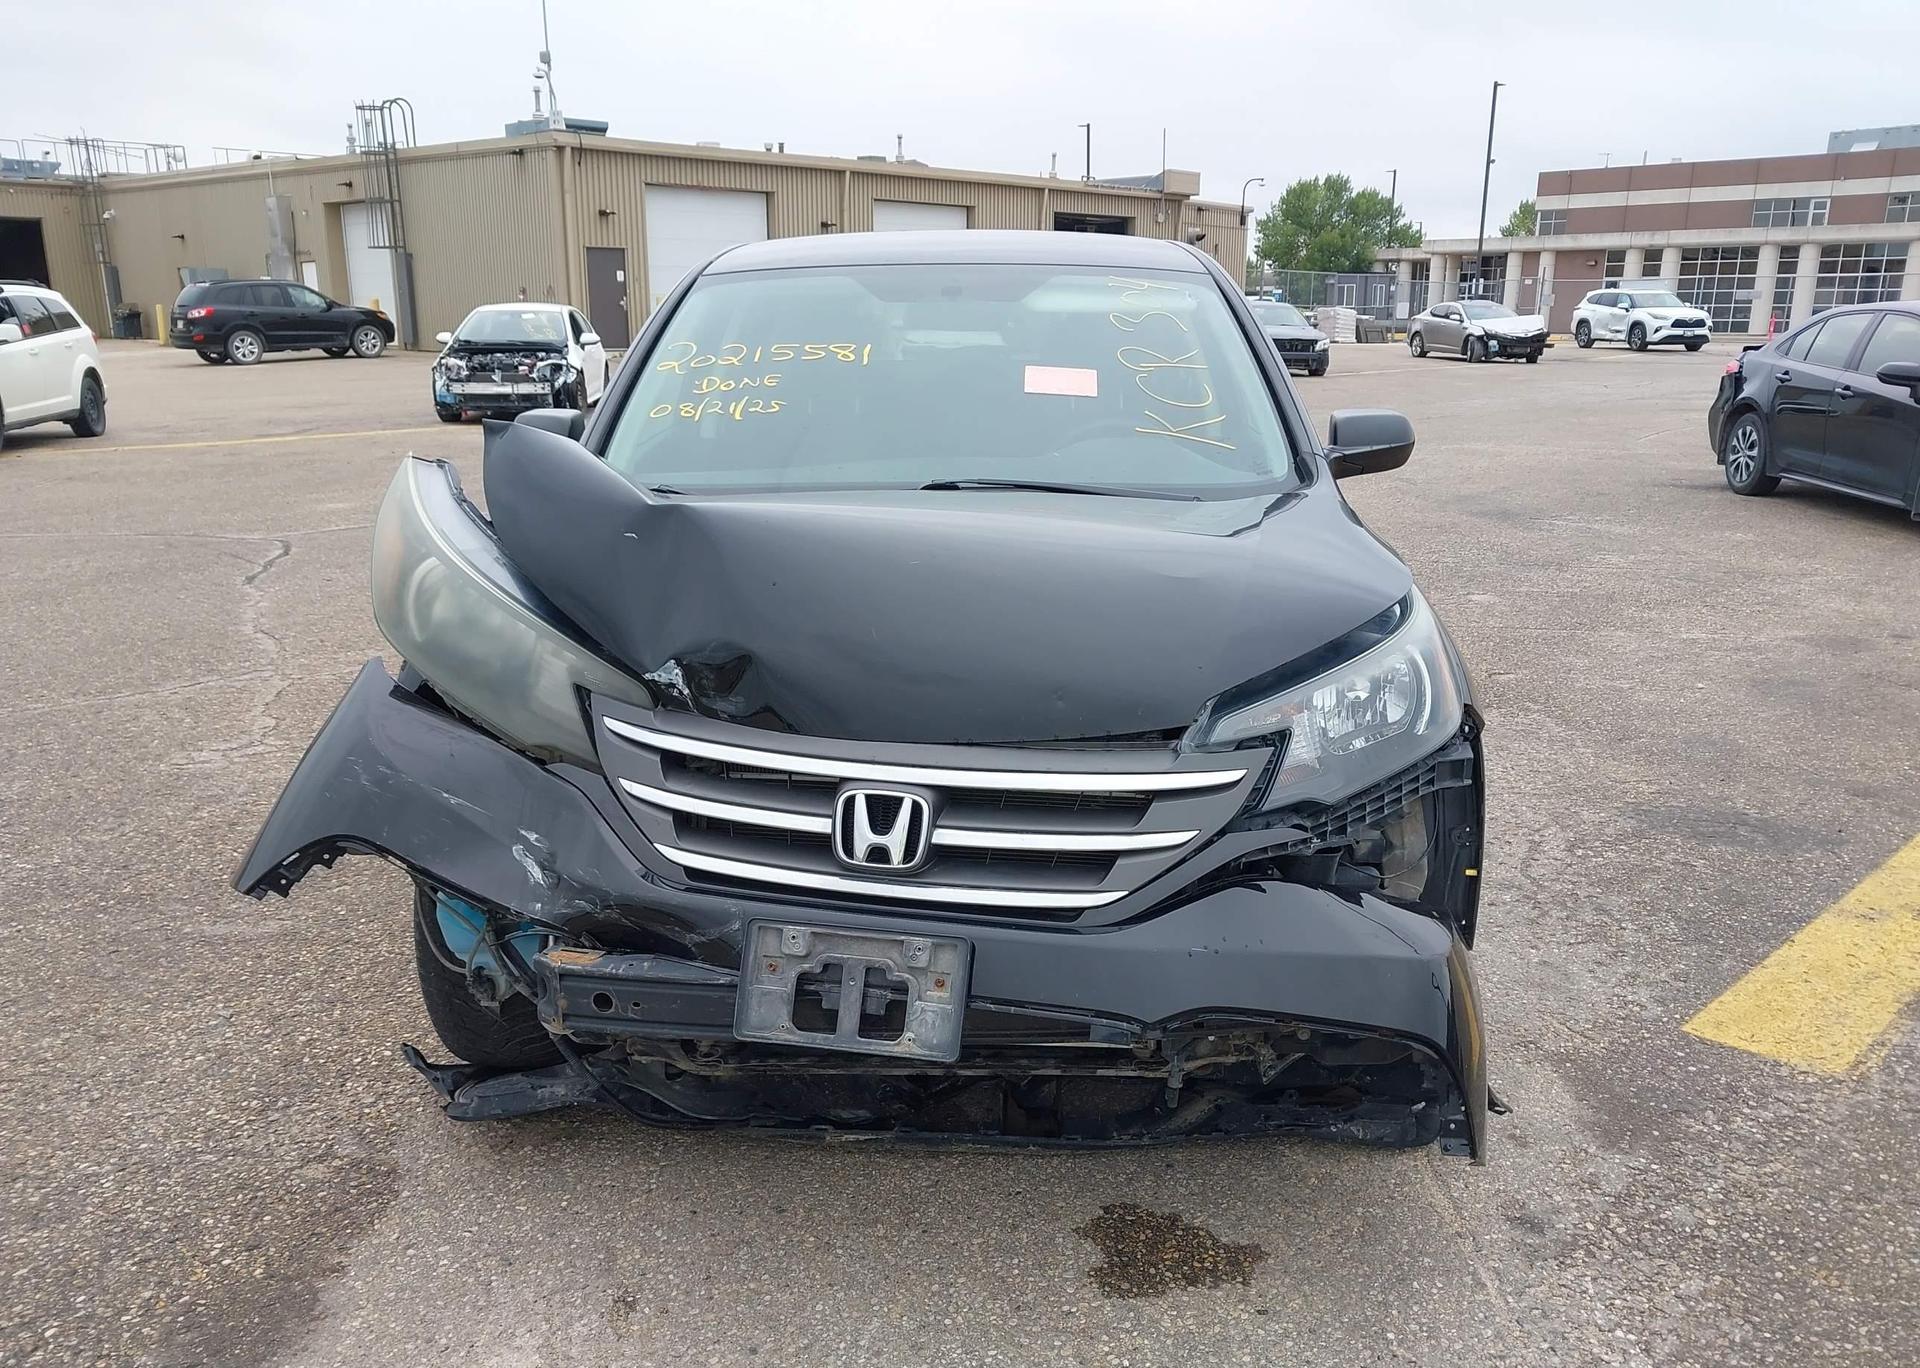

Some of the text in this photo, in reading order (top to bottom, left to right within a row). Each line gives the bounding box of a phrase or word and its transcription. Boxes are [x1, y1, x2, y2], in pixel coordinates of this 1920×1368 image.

[656, 341, 872, 375] 20215581
[693, 374, 782, 394] DONE
[649, 396, 787, 422] 08/21/25
[853, 793, 913, 867] H
